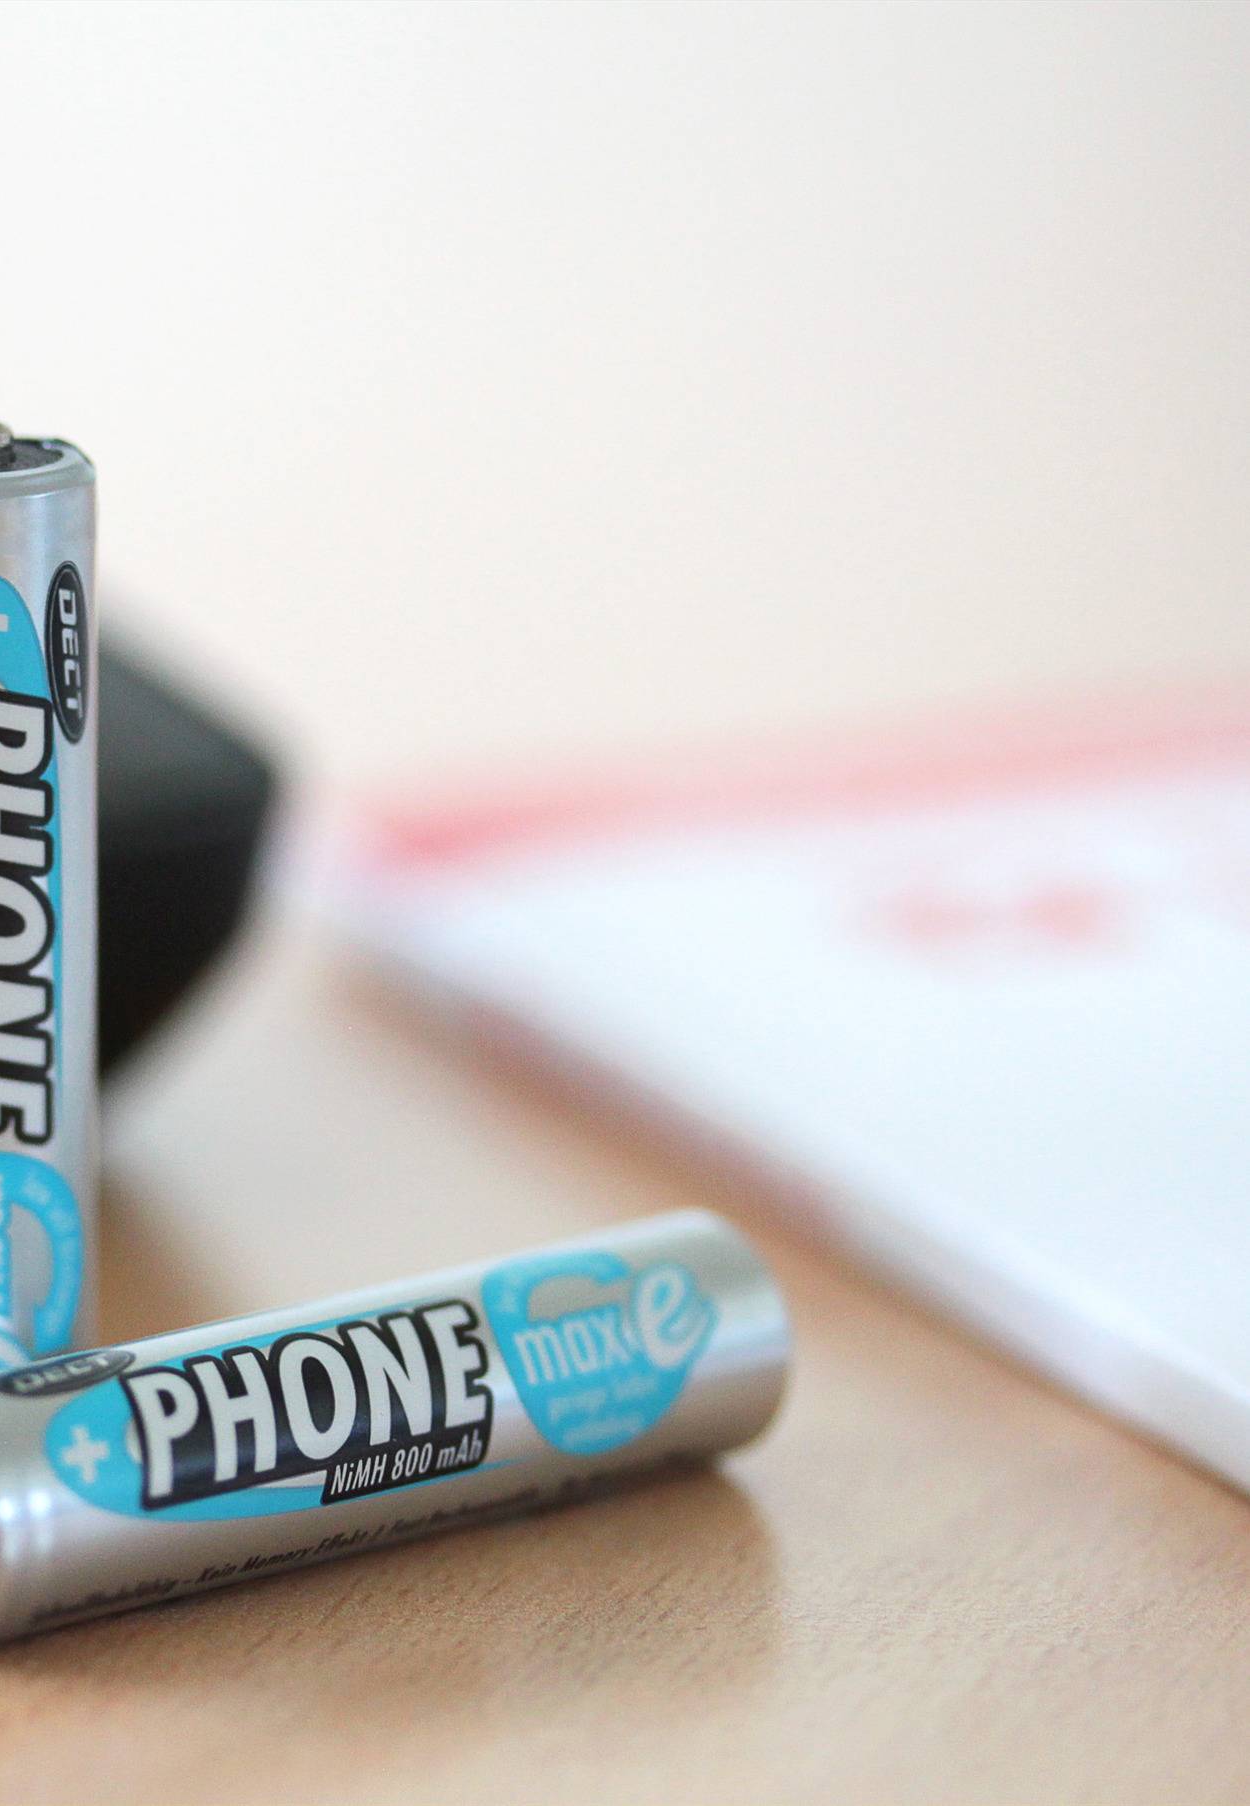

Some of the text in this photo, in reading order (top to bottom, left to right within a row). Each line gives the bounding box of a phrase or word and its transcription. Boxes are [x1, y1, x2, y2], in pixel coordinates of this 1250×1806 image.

[58, 588, 83, 718] DECT
[13, 1352, 112, 1391] DECT
[127, 1305, 487, 1498] PHONE
[330, 1428, 484, 1495] NiMH 800 mAh
